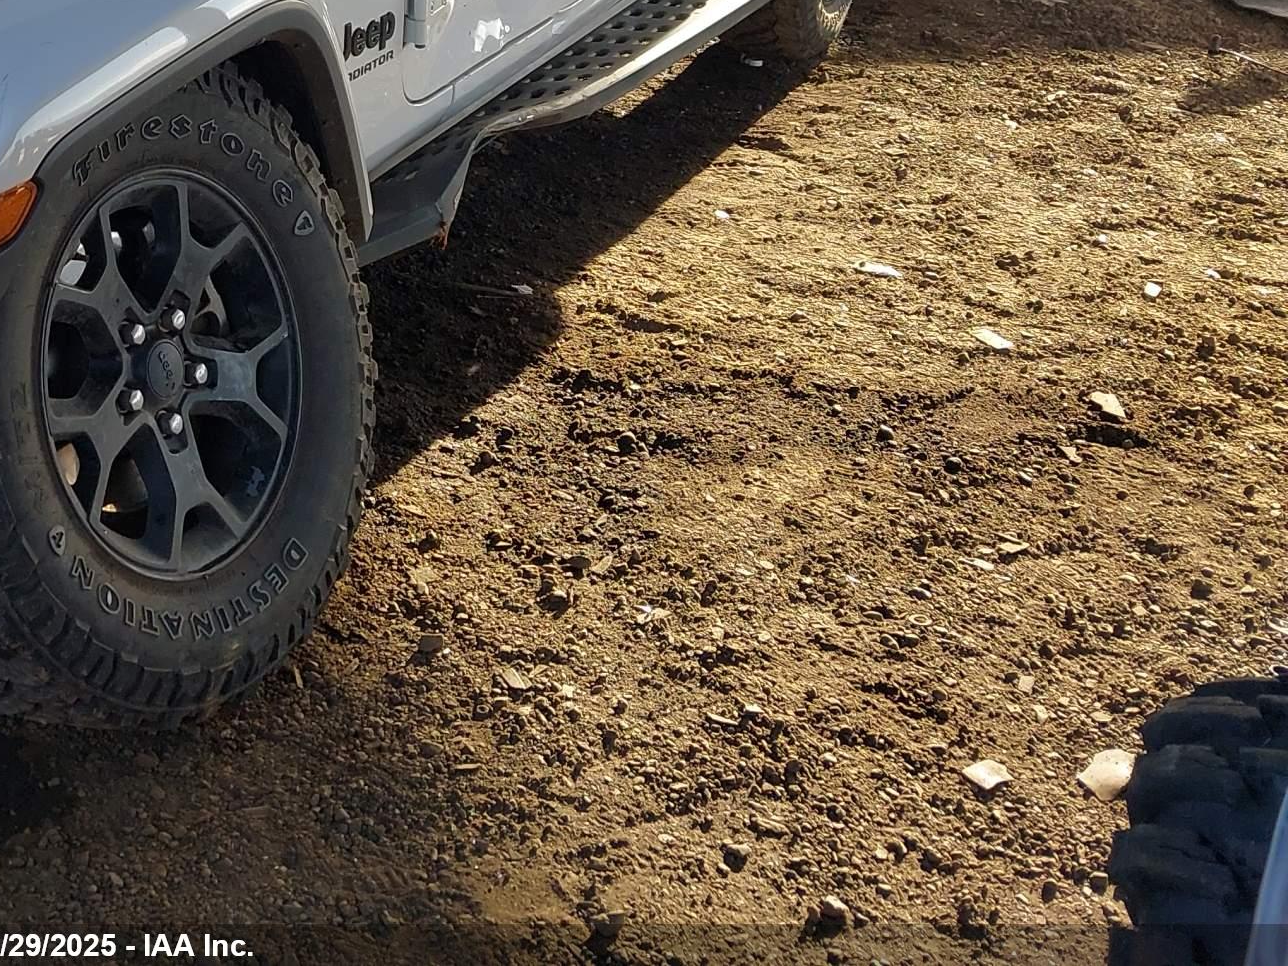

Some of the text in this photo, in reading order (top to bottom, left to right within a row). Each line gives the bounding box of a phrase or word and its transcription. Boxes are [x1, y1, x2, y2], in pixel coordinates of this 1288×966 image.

[343, 11, 396, 62] Jeep
[73, 114, 295, 207] Firestone
[71, 537, 310, 642] DESTINATION
